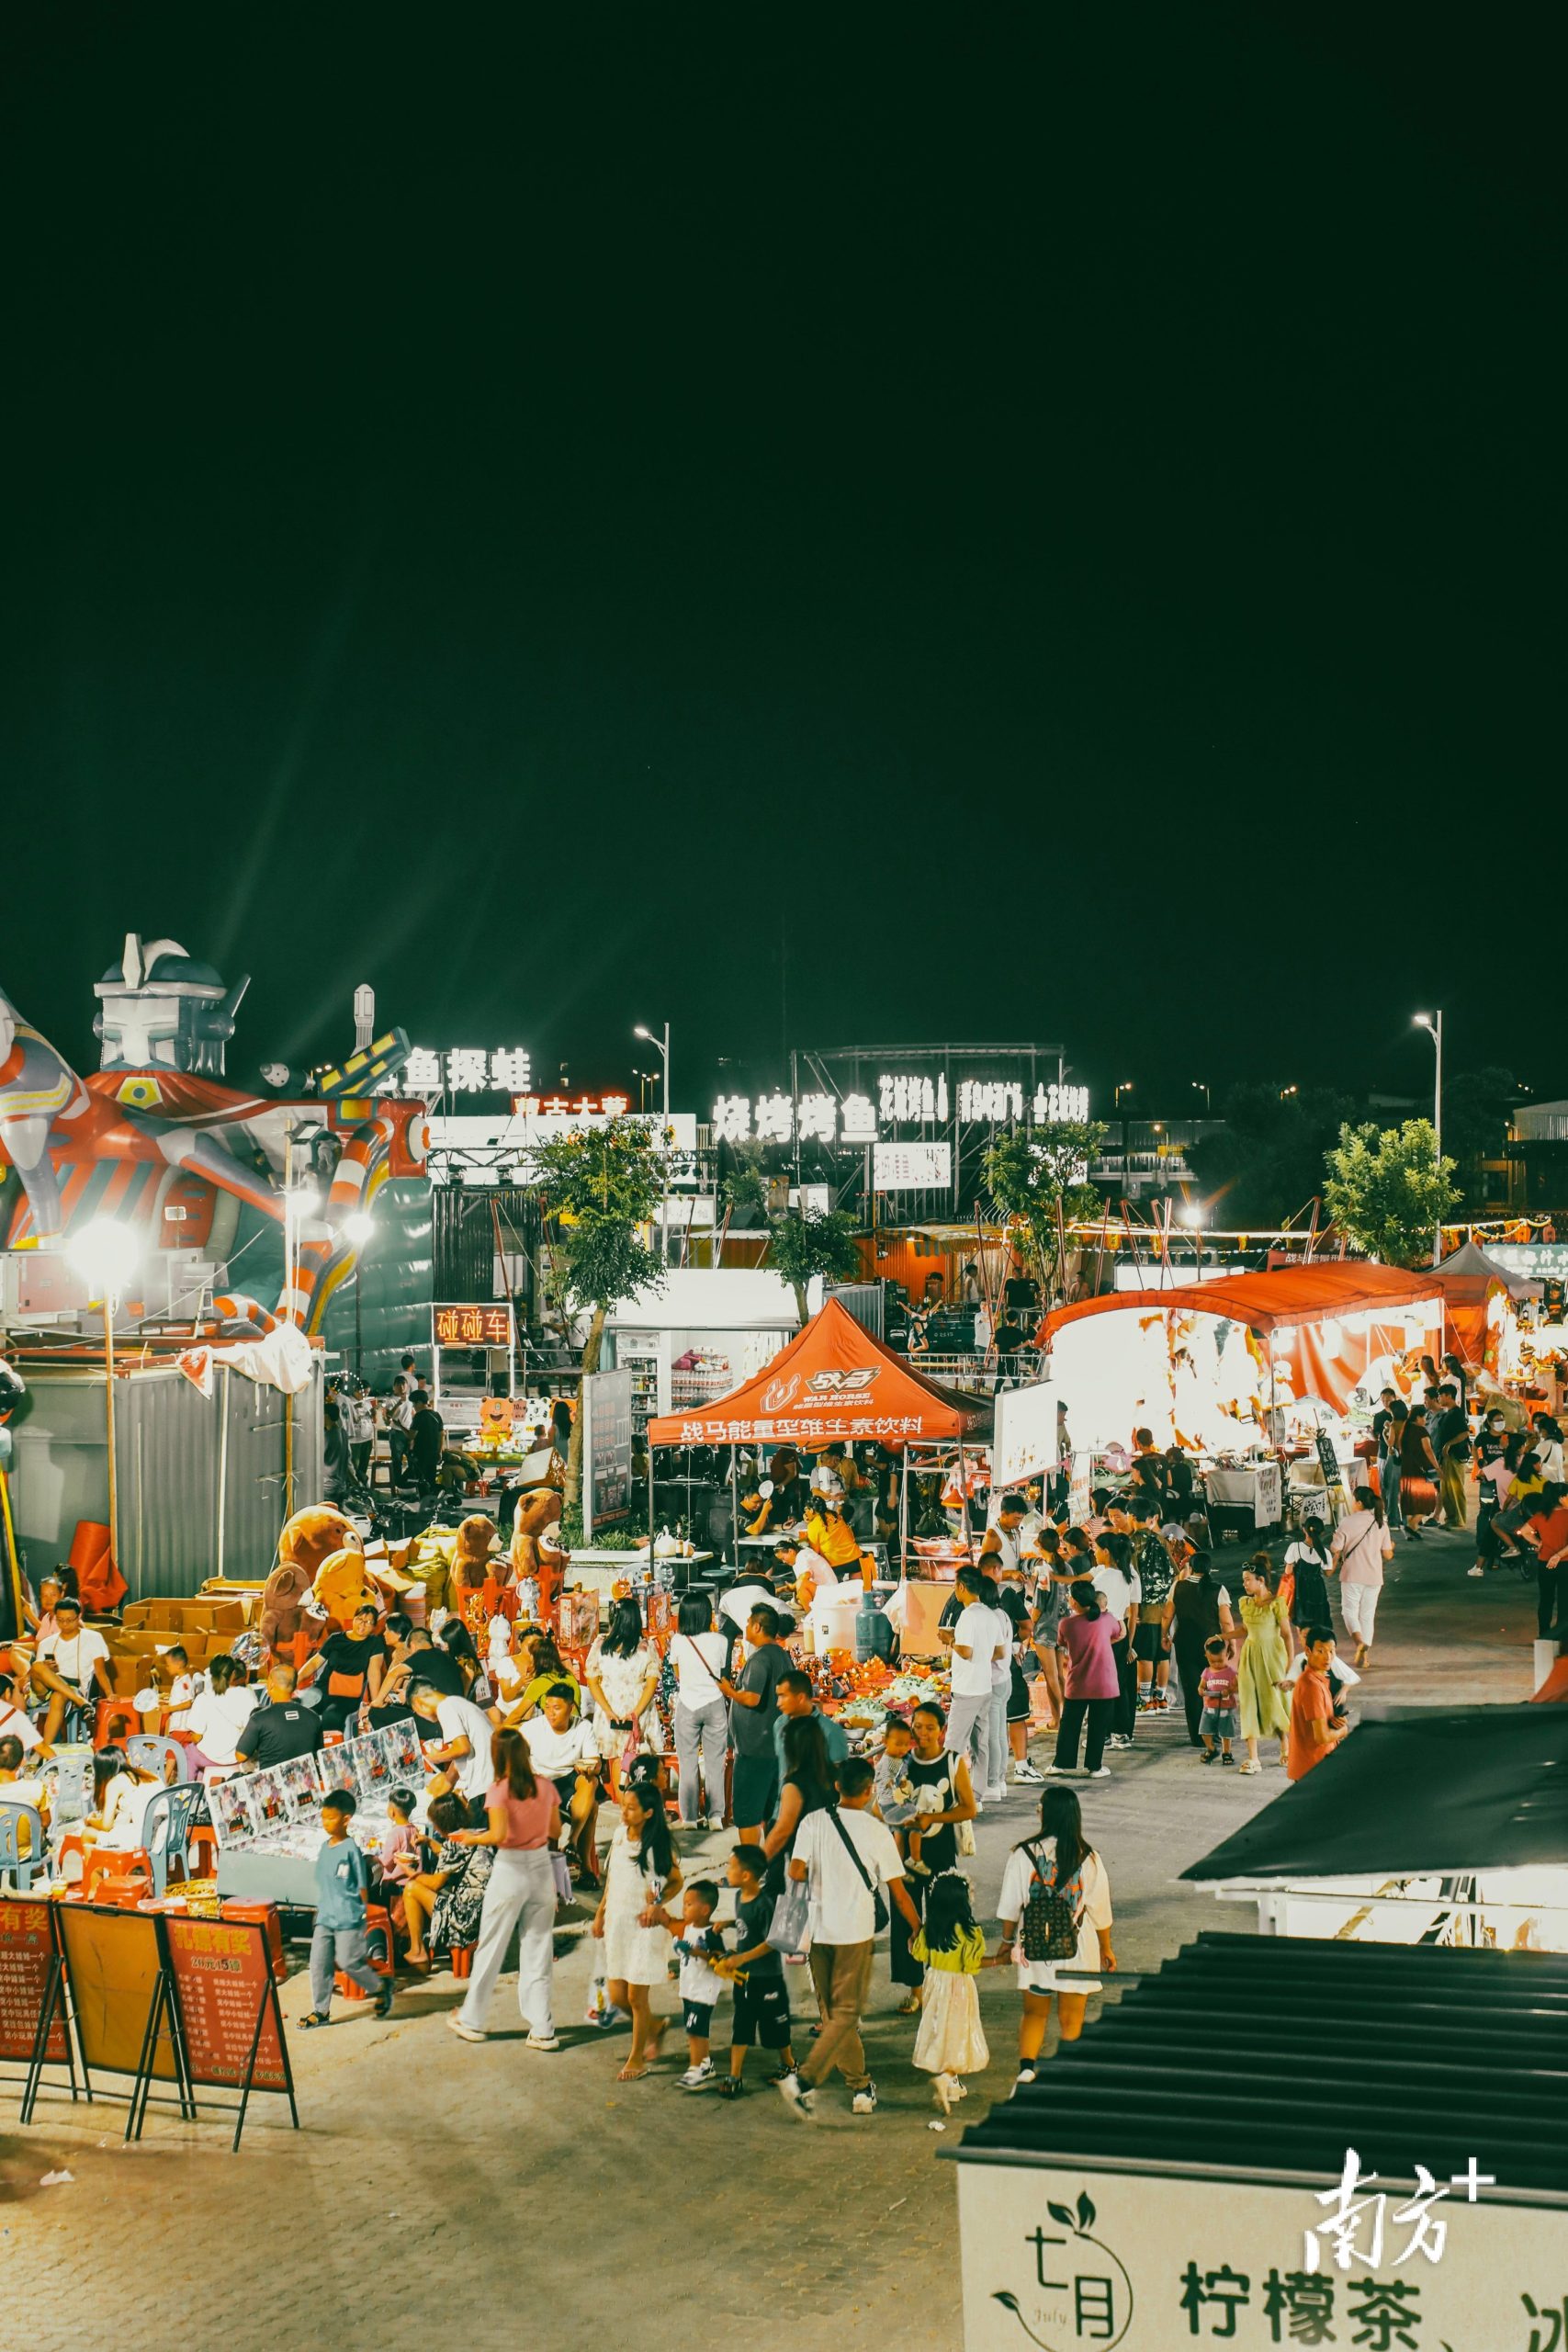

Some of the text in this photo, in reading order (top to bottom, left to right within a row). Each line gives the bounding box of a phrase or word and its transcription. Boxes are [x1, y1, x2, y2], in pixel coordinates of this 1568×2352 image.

[712, 1093, 879, 1143] 烧烤烤鱼
[437, 1309, 508, 1342] 碰碰车
[812, 1369, 874, 1389] 战马
[803, 1393, 871, 1404] WAR HORSE
[681, 1416, 923, 1442] 战马能量型维生素饮料
[1025, 2226, 1114, 2339] 七月
